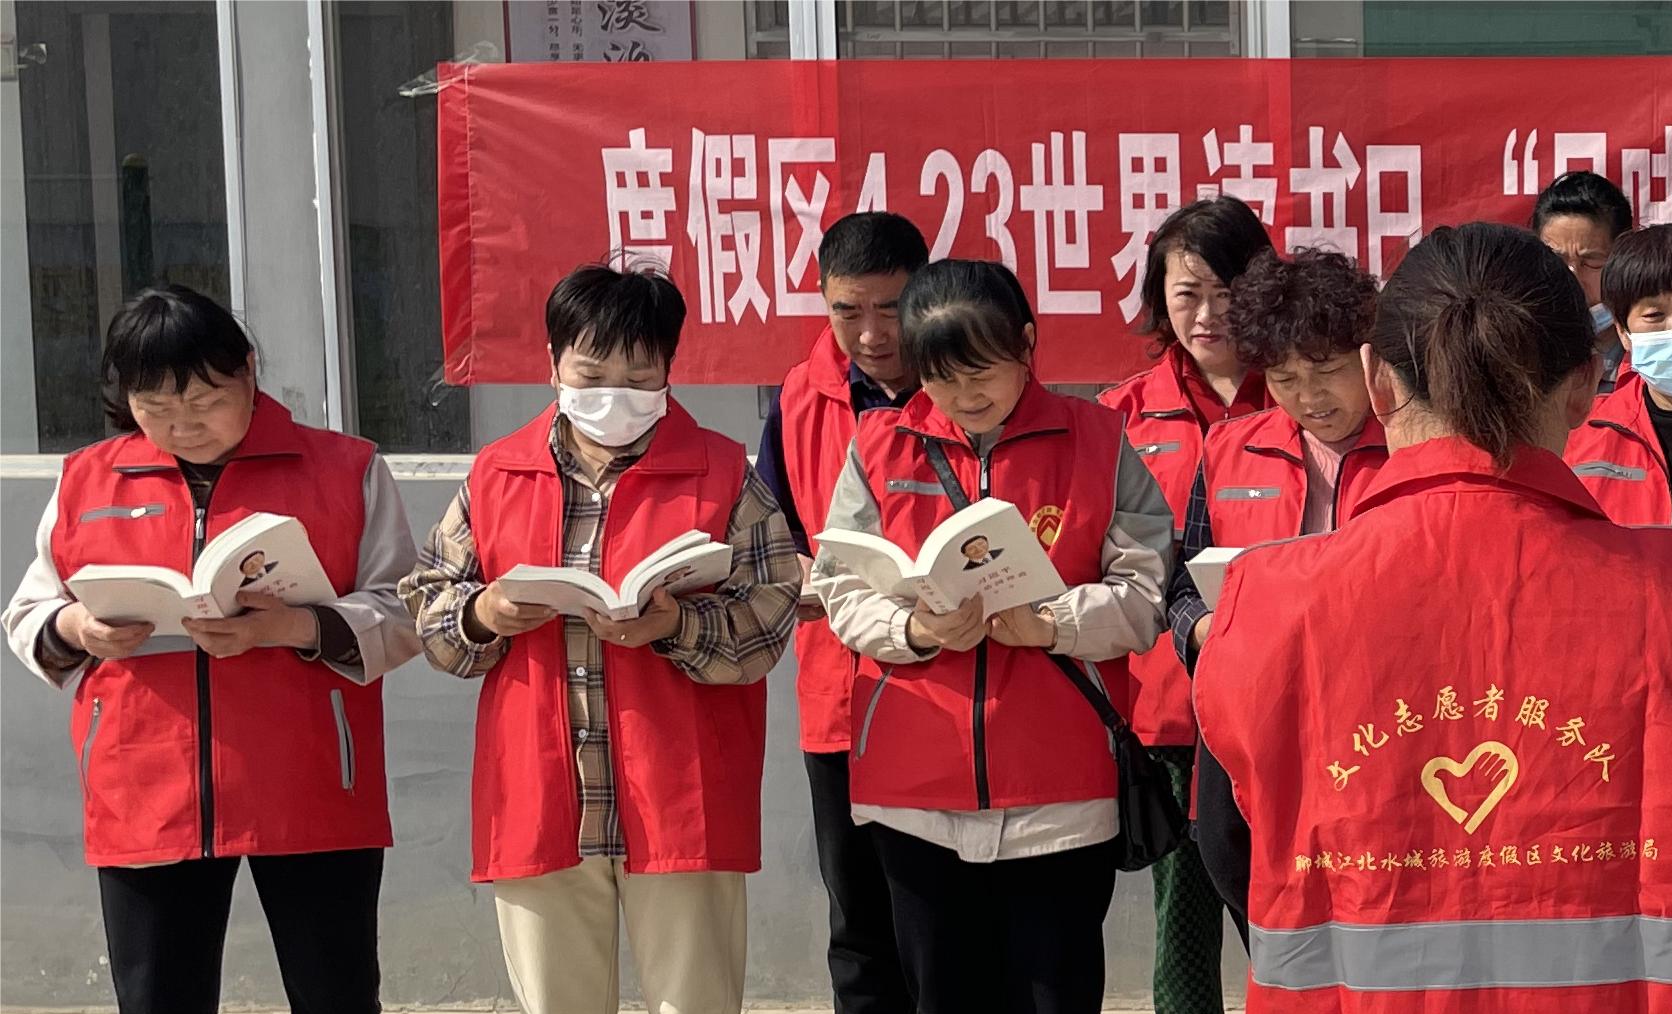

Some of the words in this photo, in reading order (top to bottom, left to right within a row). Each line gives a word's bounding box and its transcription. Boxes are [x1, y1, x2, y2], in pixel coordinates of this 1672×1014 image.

[601, 124, 1423, 326] 度假区23世界书日
